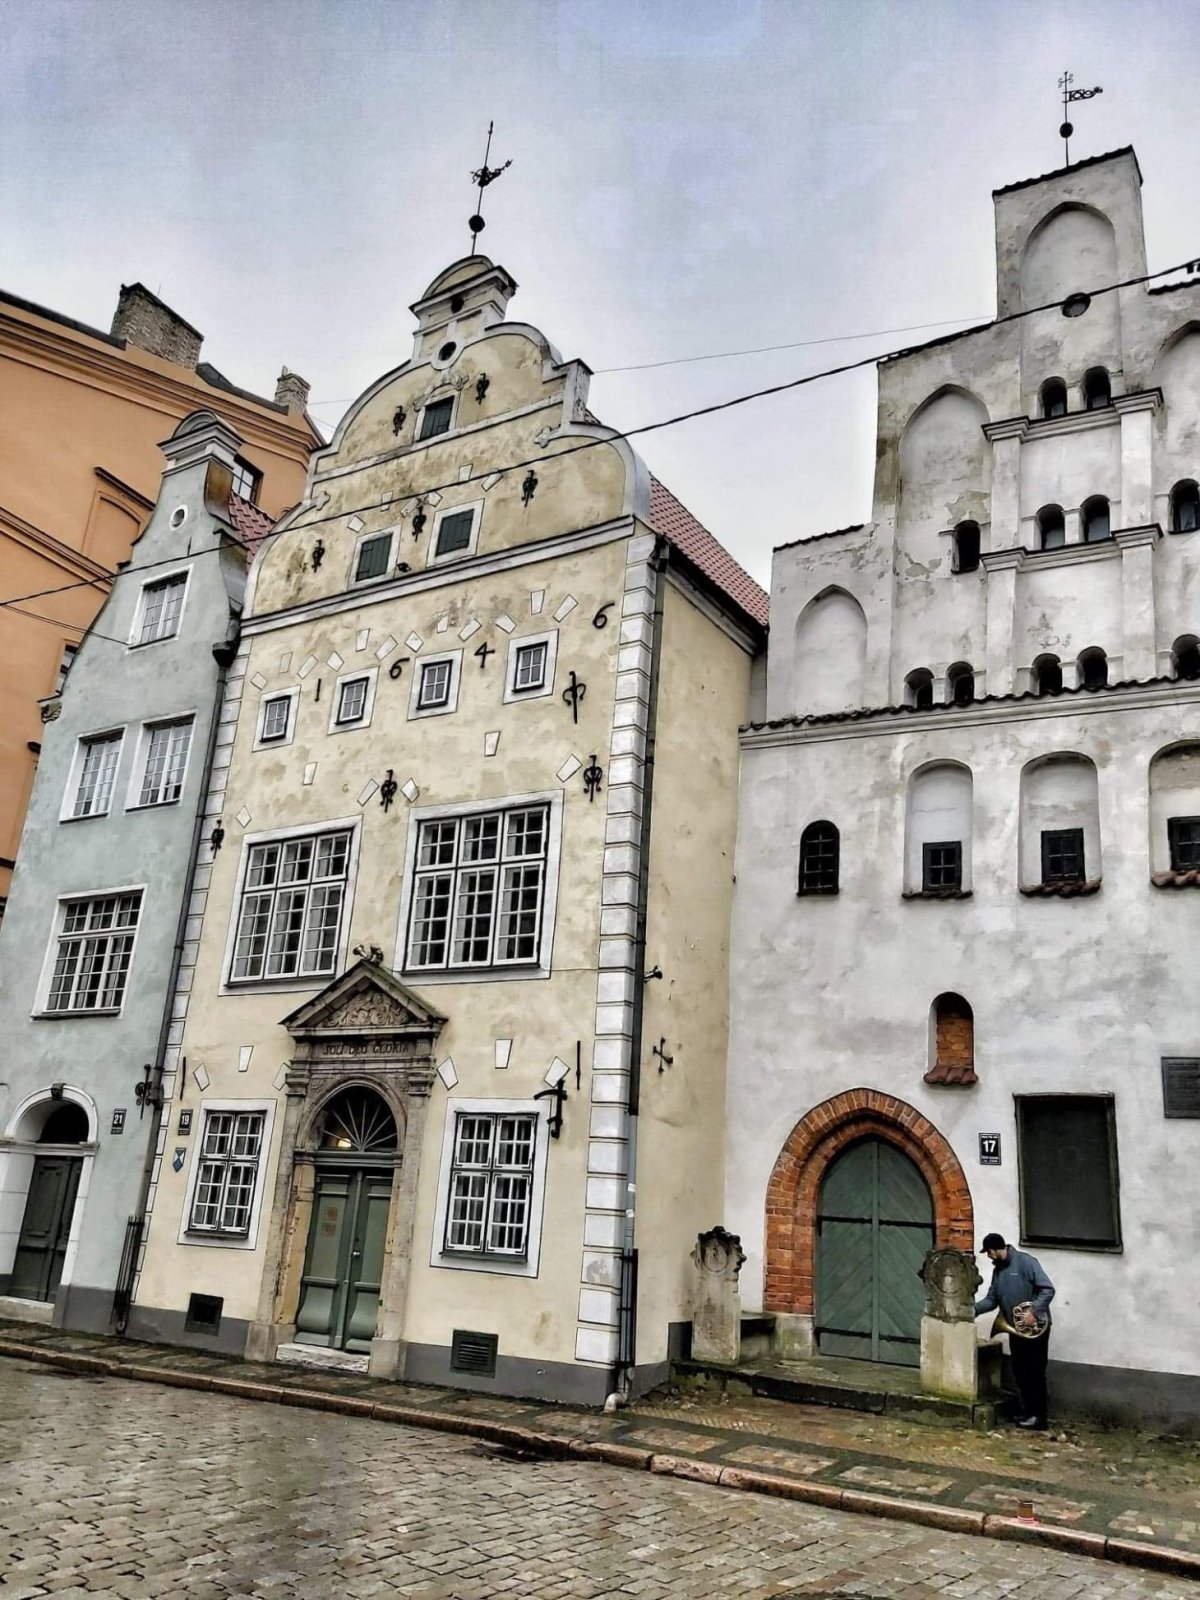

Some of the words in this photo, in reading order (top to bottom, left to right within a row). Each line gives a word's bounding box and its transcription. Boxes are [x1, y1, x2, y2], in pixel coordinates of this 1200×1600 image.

[389, 657, 410, 679] 6
[474, 642, 495, 668] 4
[593, 602, 615, 629] 6
[373, 1043, 408, 1054] GLORIA
[113, 1114, 122, 1124] 21
[181, 1114, 189, 1125] 19
[982, 1140, 996, 1152] 17
